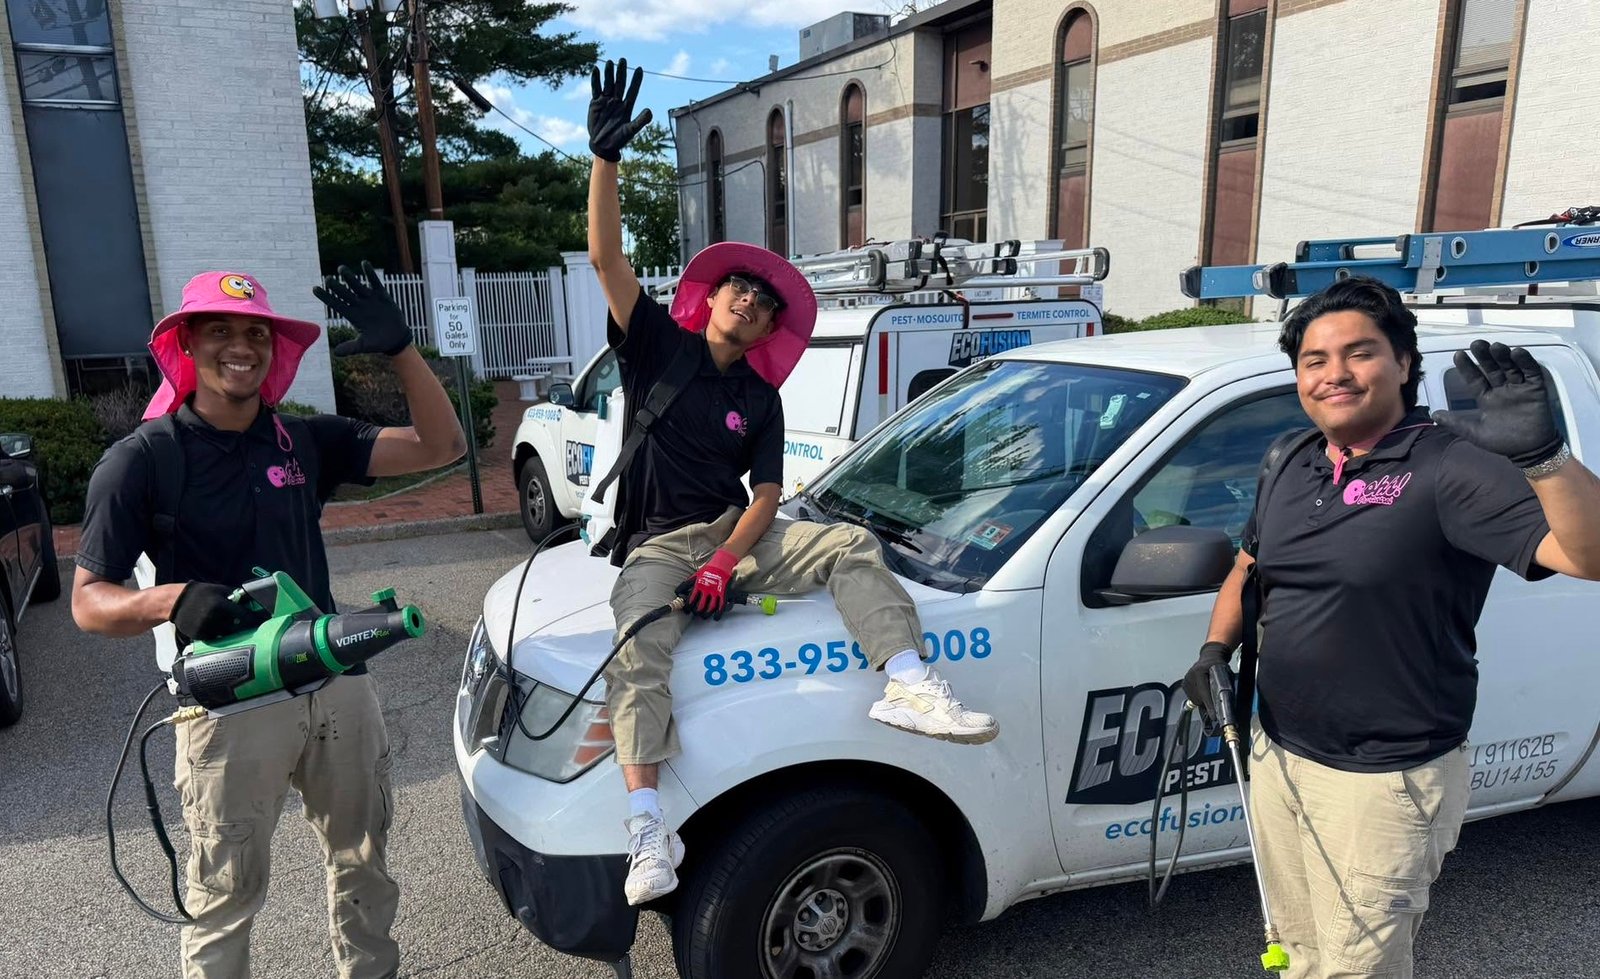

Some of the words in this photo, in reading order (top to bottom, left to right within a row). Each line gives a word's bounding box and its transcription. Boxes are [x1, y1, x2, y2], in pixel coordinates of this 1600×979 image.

[1575, 236, 1600, 245] RNER
[438, 303, 468, 313] Parking
[449, 313, 459, 321] for
[1017, 310, 1051, 321] TERMITE
[1052, 308, 1091, 319] CONTROL
[448, 321, 463, 332] 50
[449, 340, 466, 350] Only
[950, 331, 1031, 362] ECOFUSION
[784, 440, 824, 461] ONTROL
[336, 628, 379, 648] VORTEX
[703, 627, 992, 686] 833-959008
[1074, 684, 1221, 792] ECO
[1485, 734, 1555, 765] 91162B
[1470, 759, 1559, 791] BU14155
